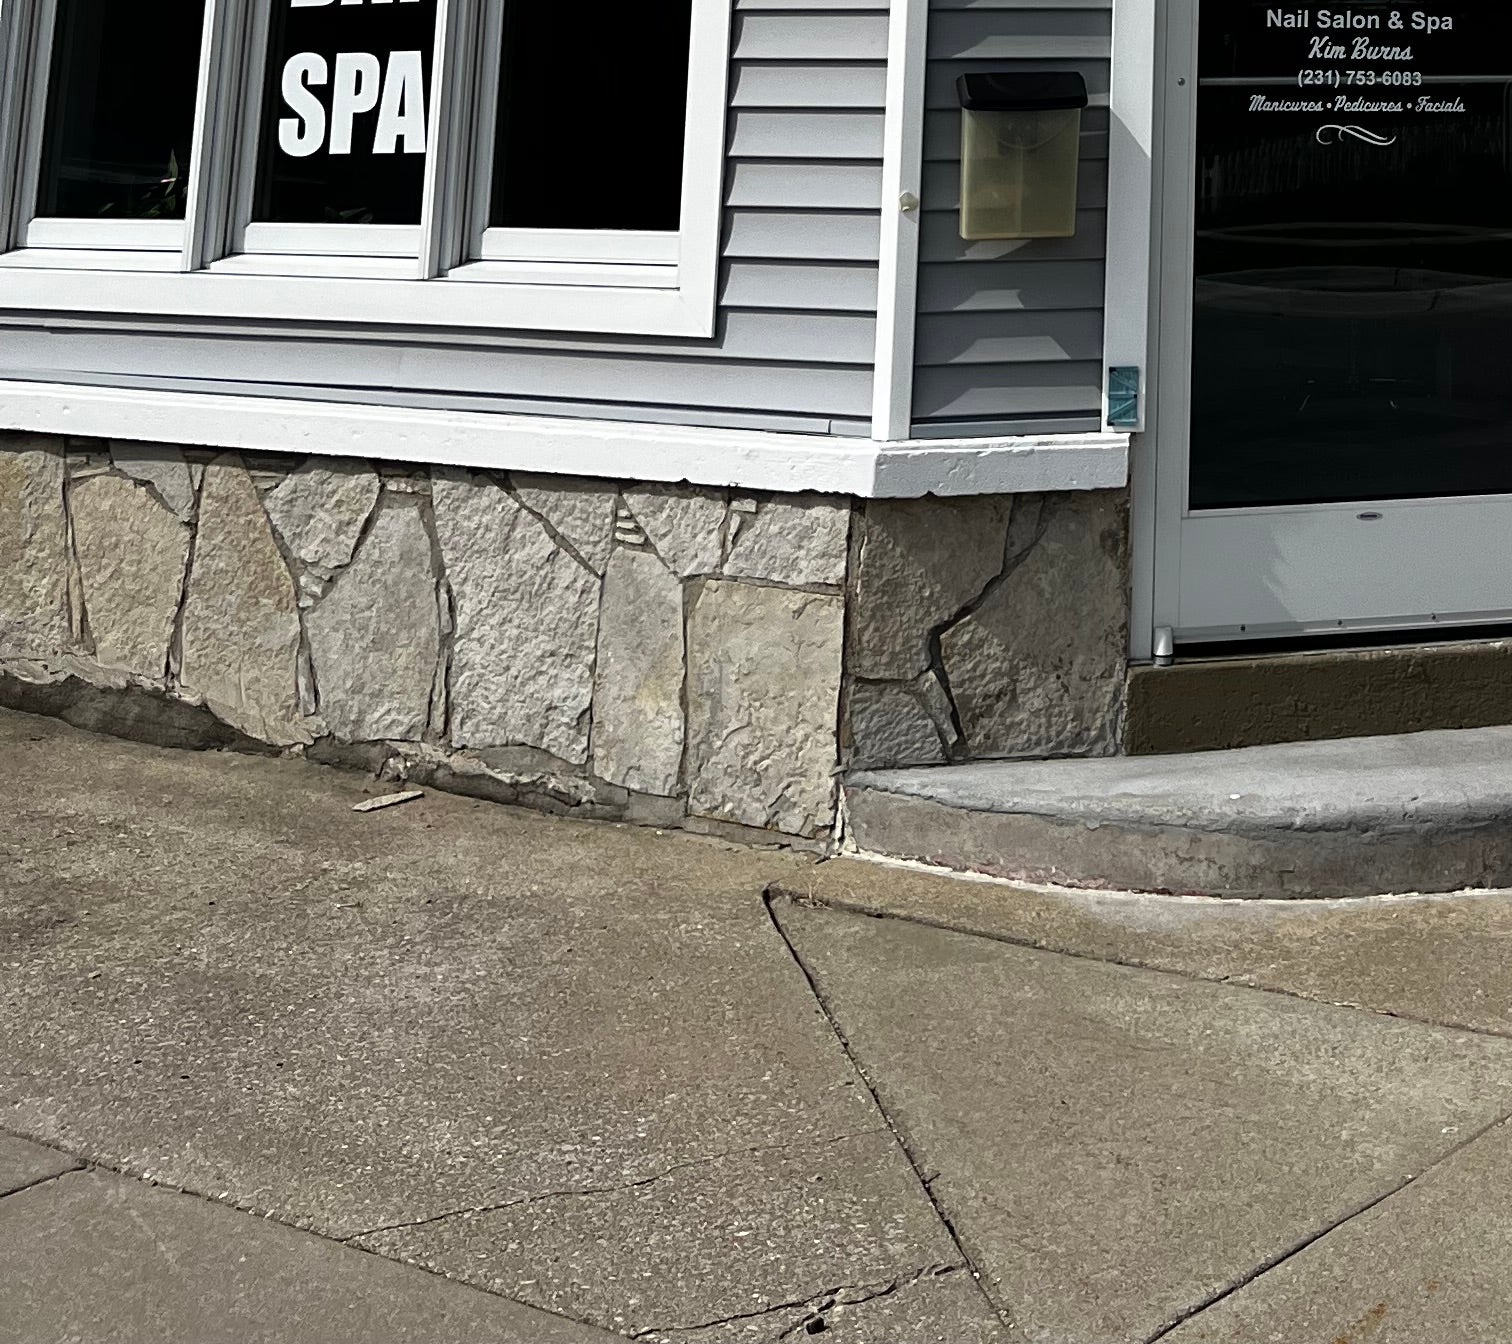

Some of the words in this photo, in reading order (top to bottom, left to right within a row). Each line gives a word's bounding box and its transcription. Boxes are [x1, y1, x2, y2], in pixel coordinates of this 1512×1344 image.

[1267, 9, 1308, 27] Nail
[1317, 10, 1379, 28] Salon
[1388, 11, 1403, 29] &
[1411, 12, 1452, 34] Spa
[1308, 36, 1346, 59] Kim
[1351, 37, 1413, 60] Burns
[1298, 70, 1340, 88] (231)
[1346, 71, 1422, 87] 753-6083
[279, 51, 426, 156] SPA
[1249, 95, 1324, 111] Manicures
[1334, 95, 1403, 112] Pedicures
[1415, 96, 1465, 112] Facials
